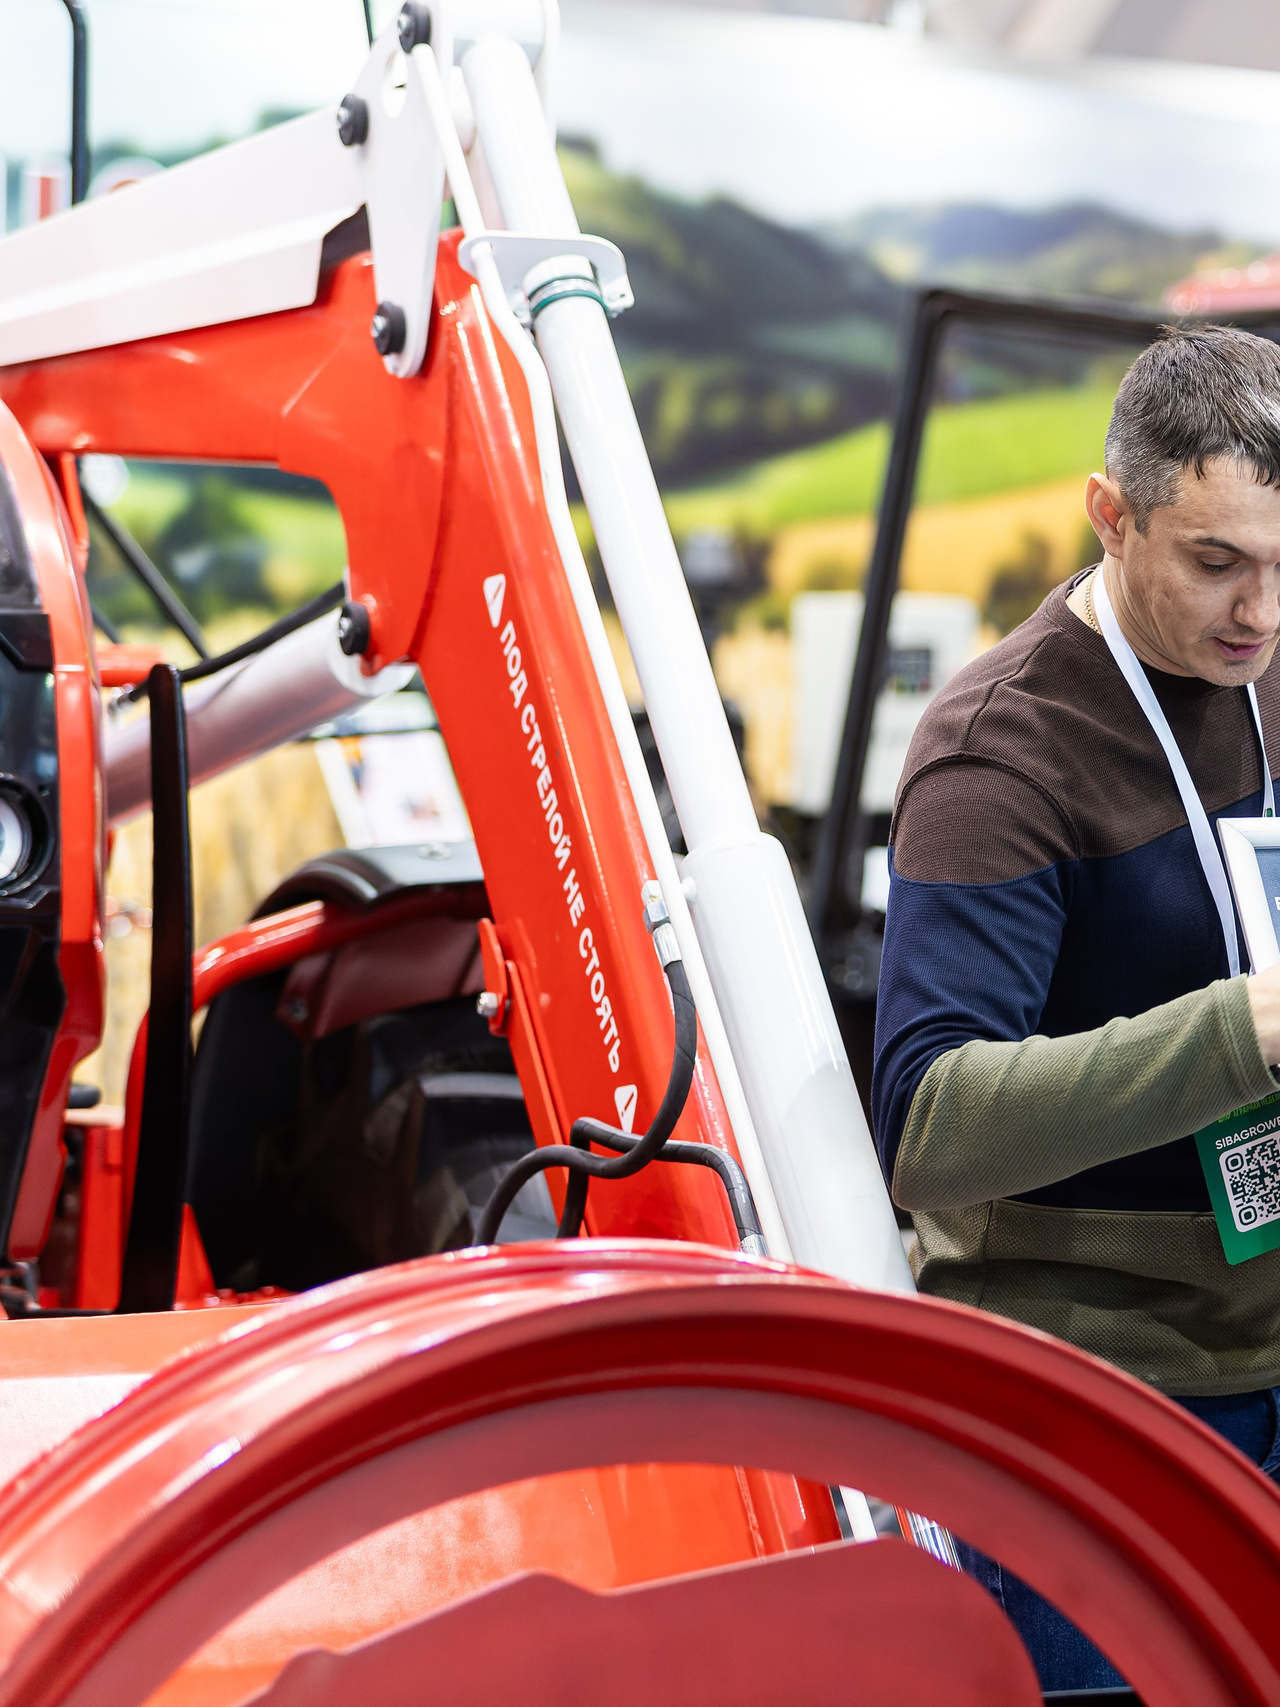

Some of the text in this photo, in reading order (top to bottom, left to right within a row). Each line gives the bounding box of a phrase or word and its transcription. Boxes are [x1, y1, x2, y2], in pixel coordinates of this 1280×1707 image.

[499, 620, 621, 1073] ПОД СТРЕЛОЙ НЕ СТОЯТЬ
